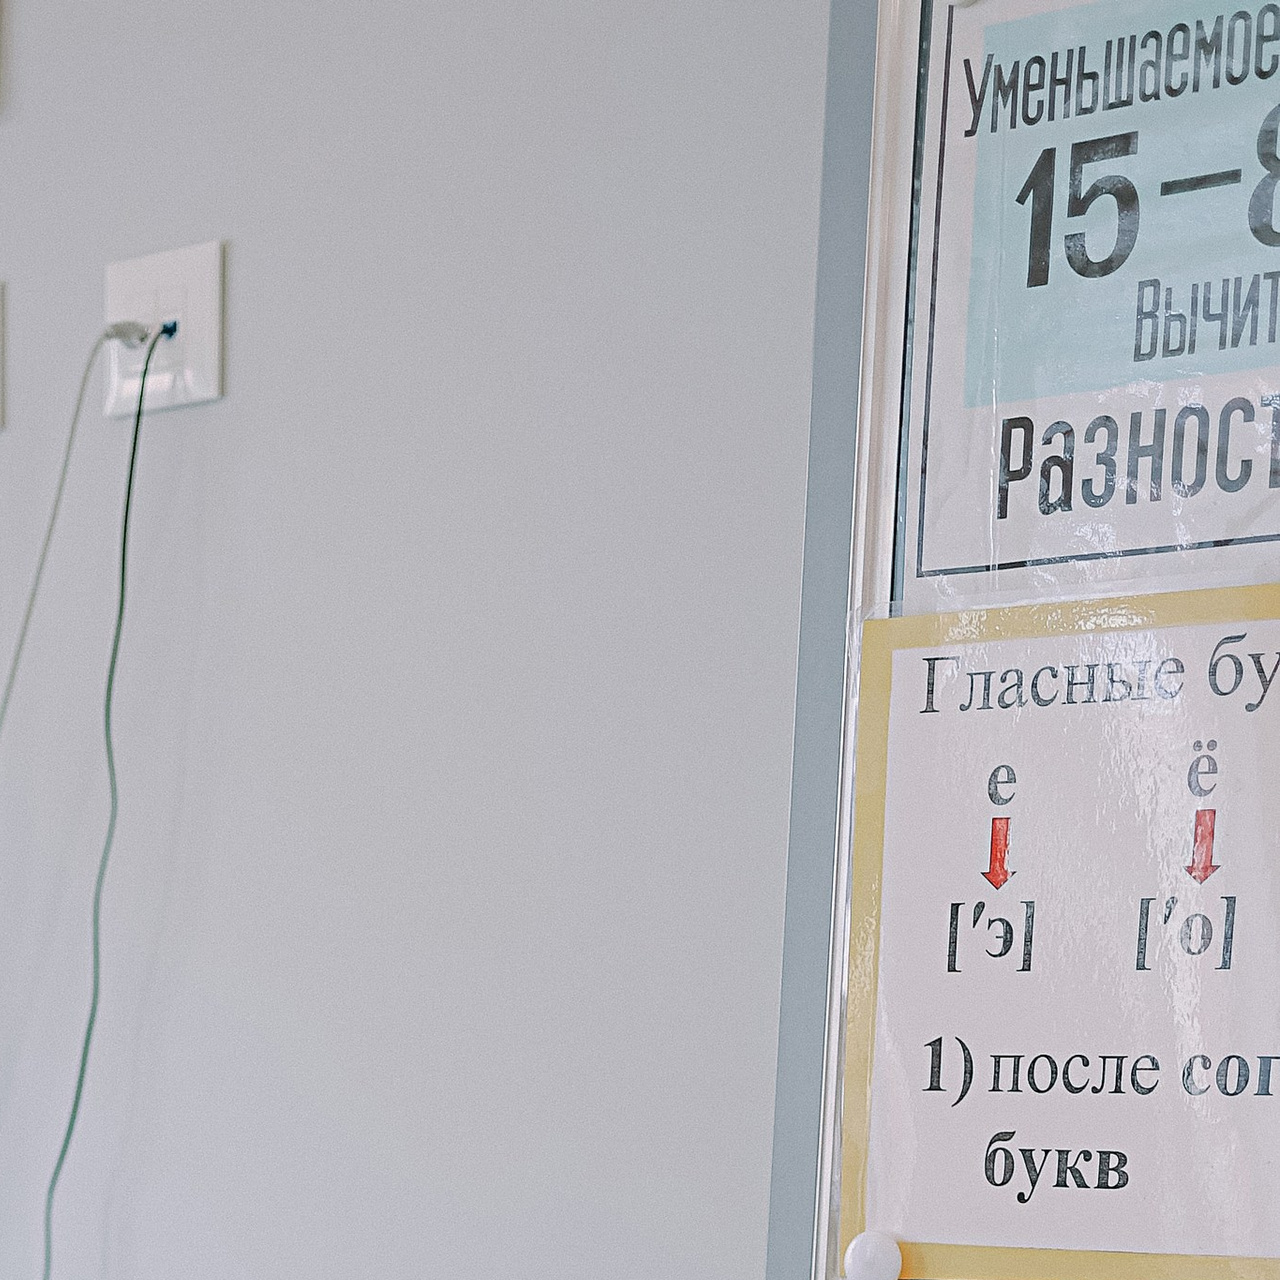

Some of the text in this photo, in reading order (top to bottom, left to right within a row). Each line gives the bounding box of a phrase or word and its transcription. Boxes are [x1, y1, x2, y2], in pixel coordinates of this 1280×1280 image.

[964, 3, 1280, 138] Уменьшаемое
[920, 633, 1280, 714] Гласные бу
[988, 740, 1217, 805] е ё
[922, 1037, 973, 1107] 1)
[988, 1054, 1160, 1095] после
[985, 1131, 1129, 1204] букв
